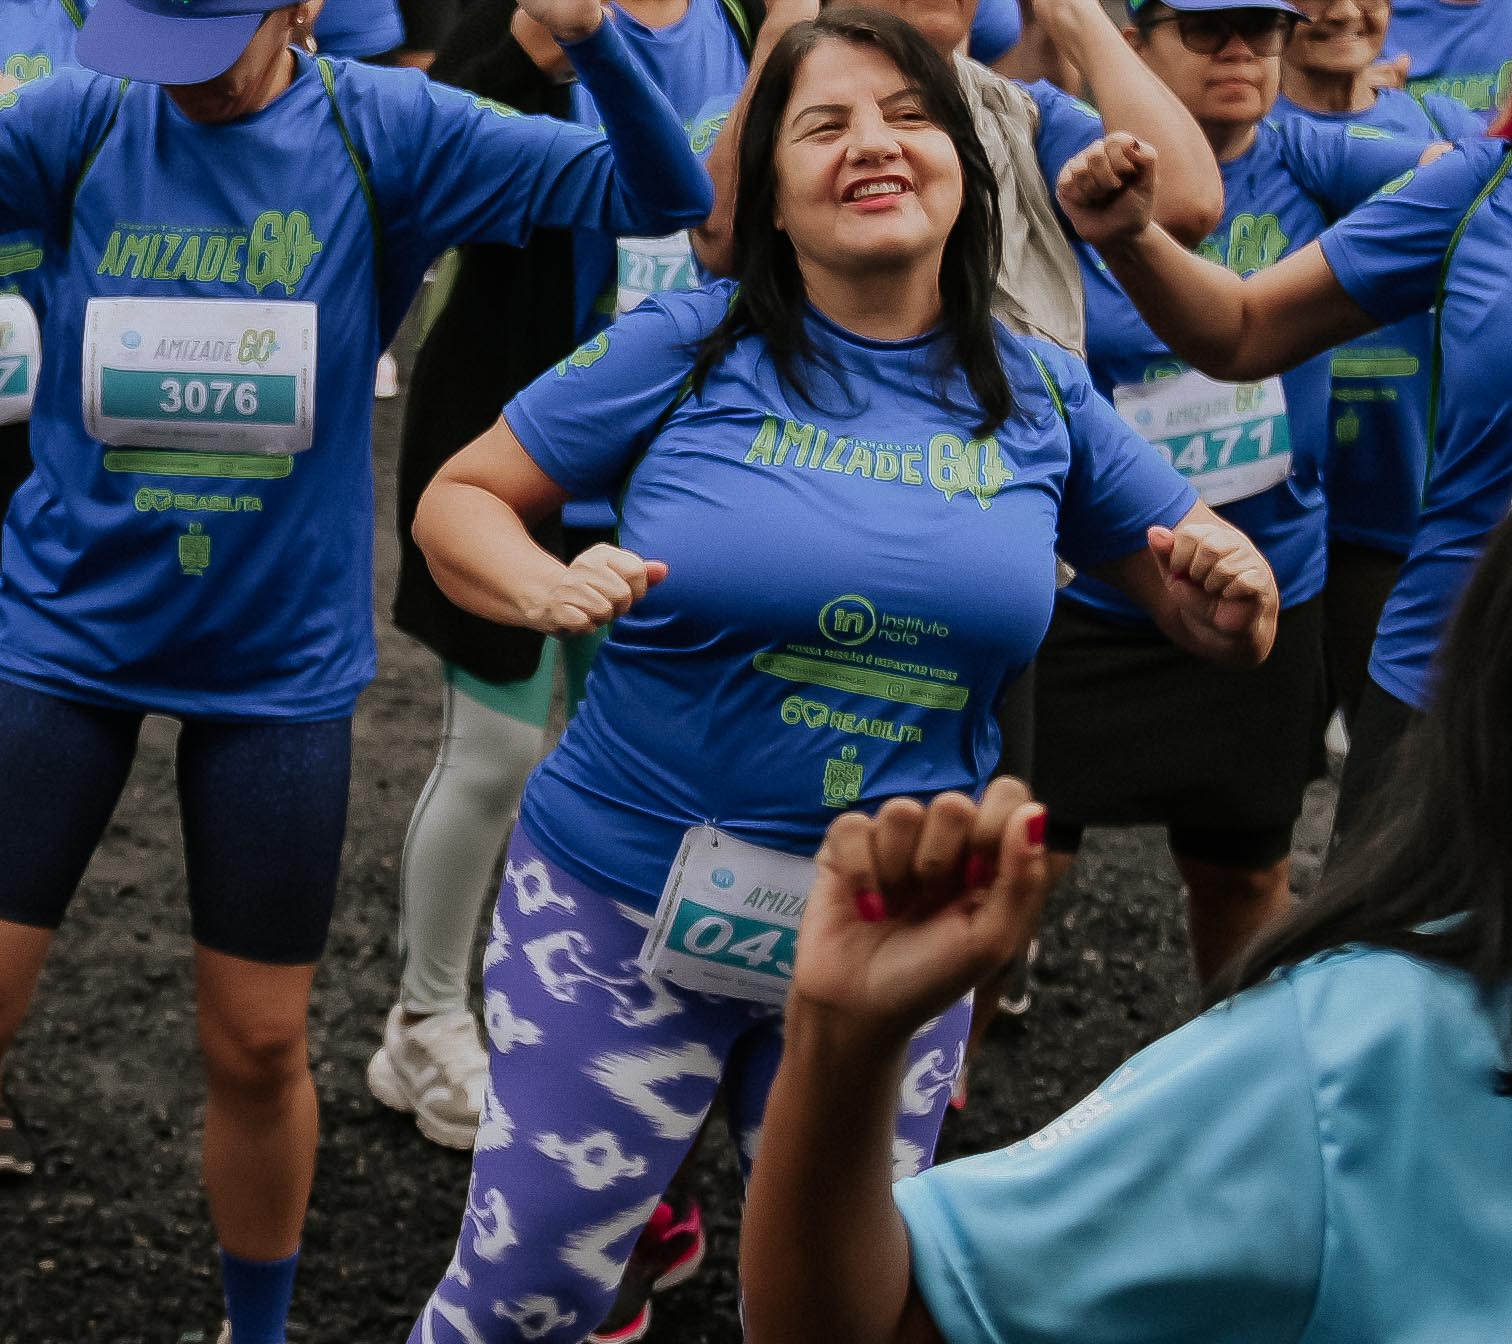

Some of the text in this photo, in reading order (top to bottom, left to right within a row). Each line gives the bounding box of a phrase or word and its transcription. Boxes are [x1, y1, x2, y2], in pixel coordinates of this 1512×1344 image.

[97, 229, 247, 283] AMIZADE
[159, 378, 259, 417] 3076
[744, 416, 925, 487] AMIZADE
[684, 916, 795, 975] 04
